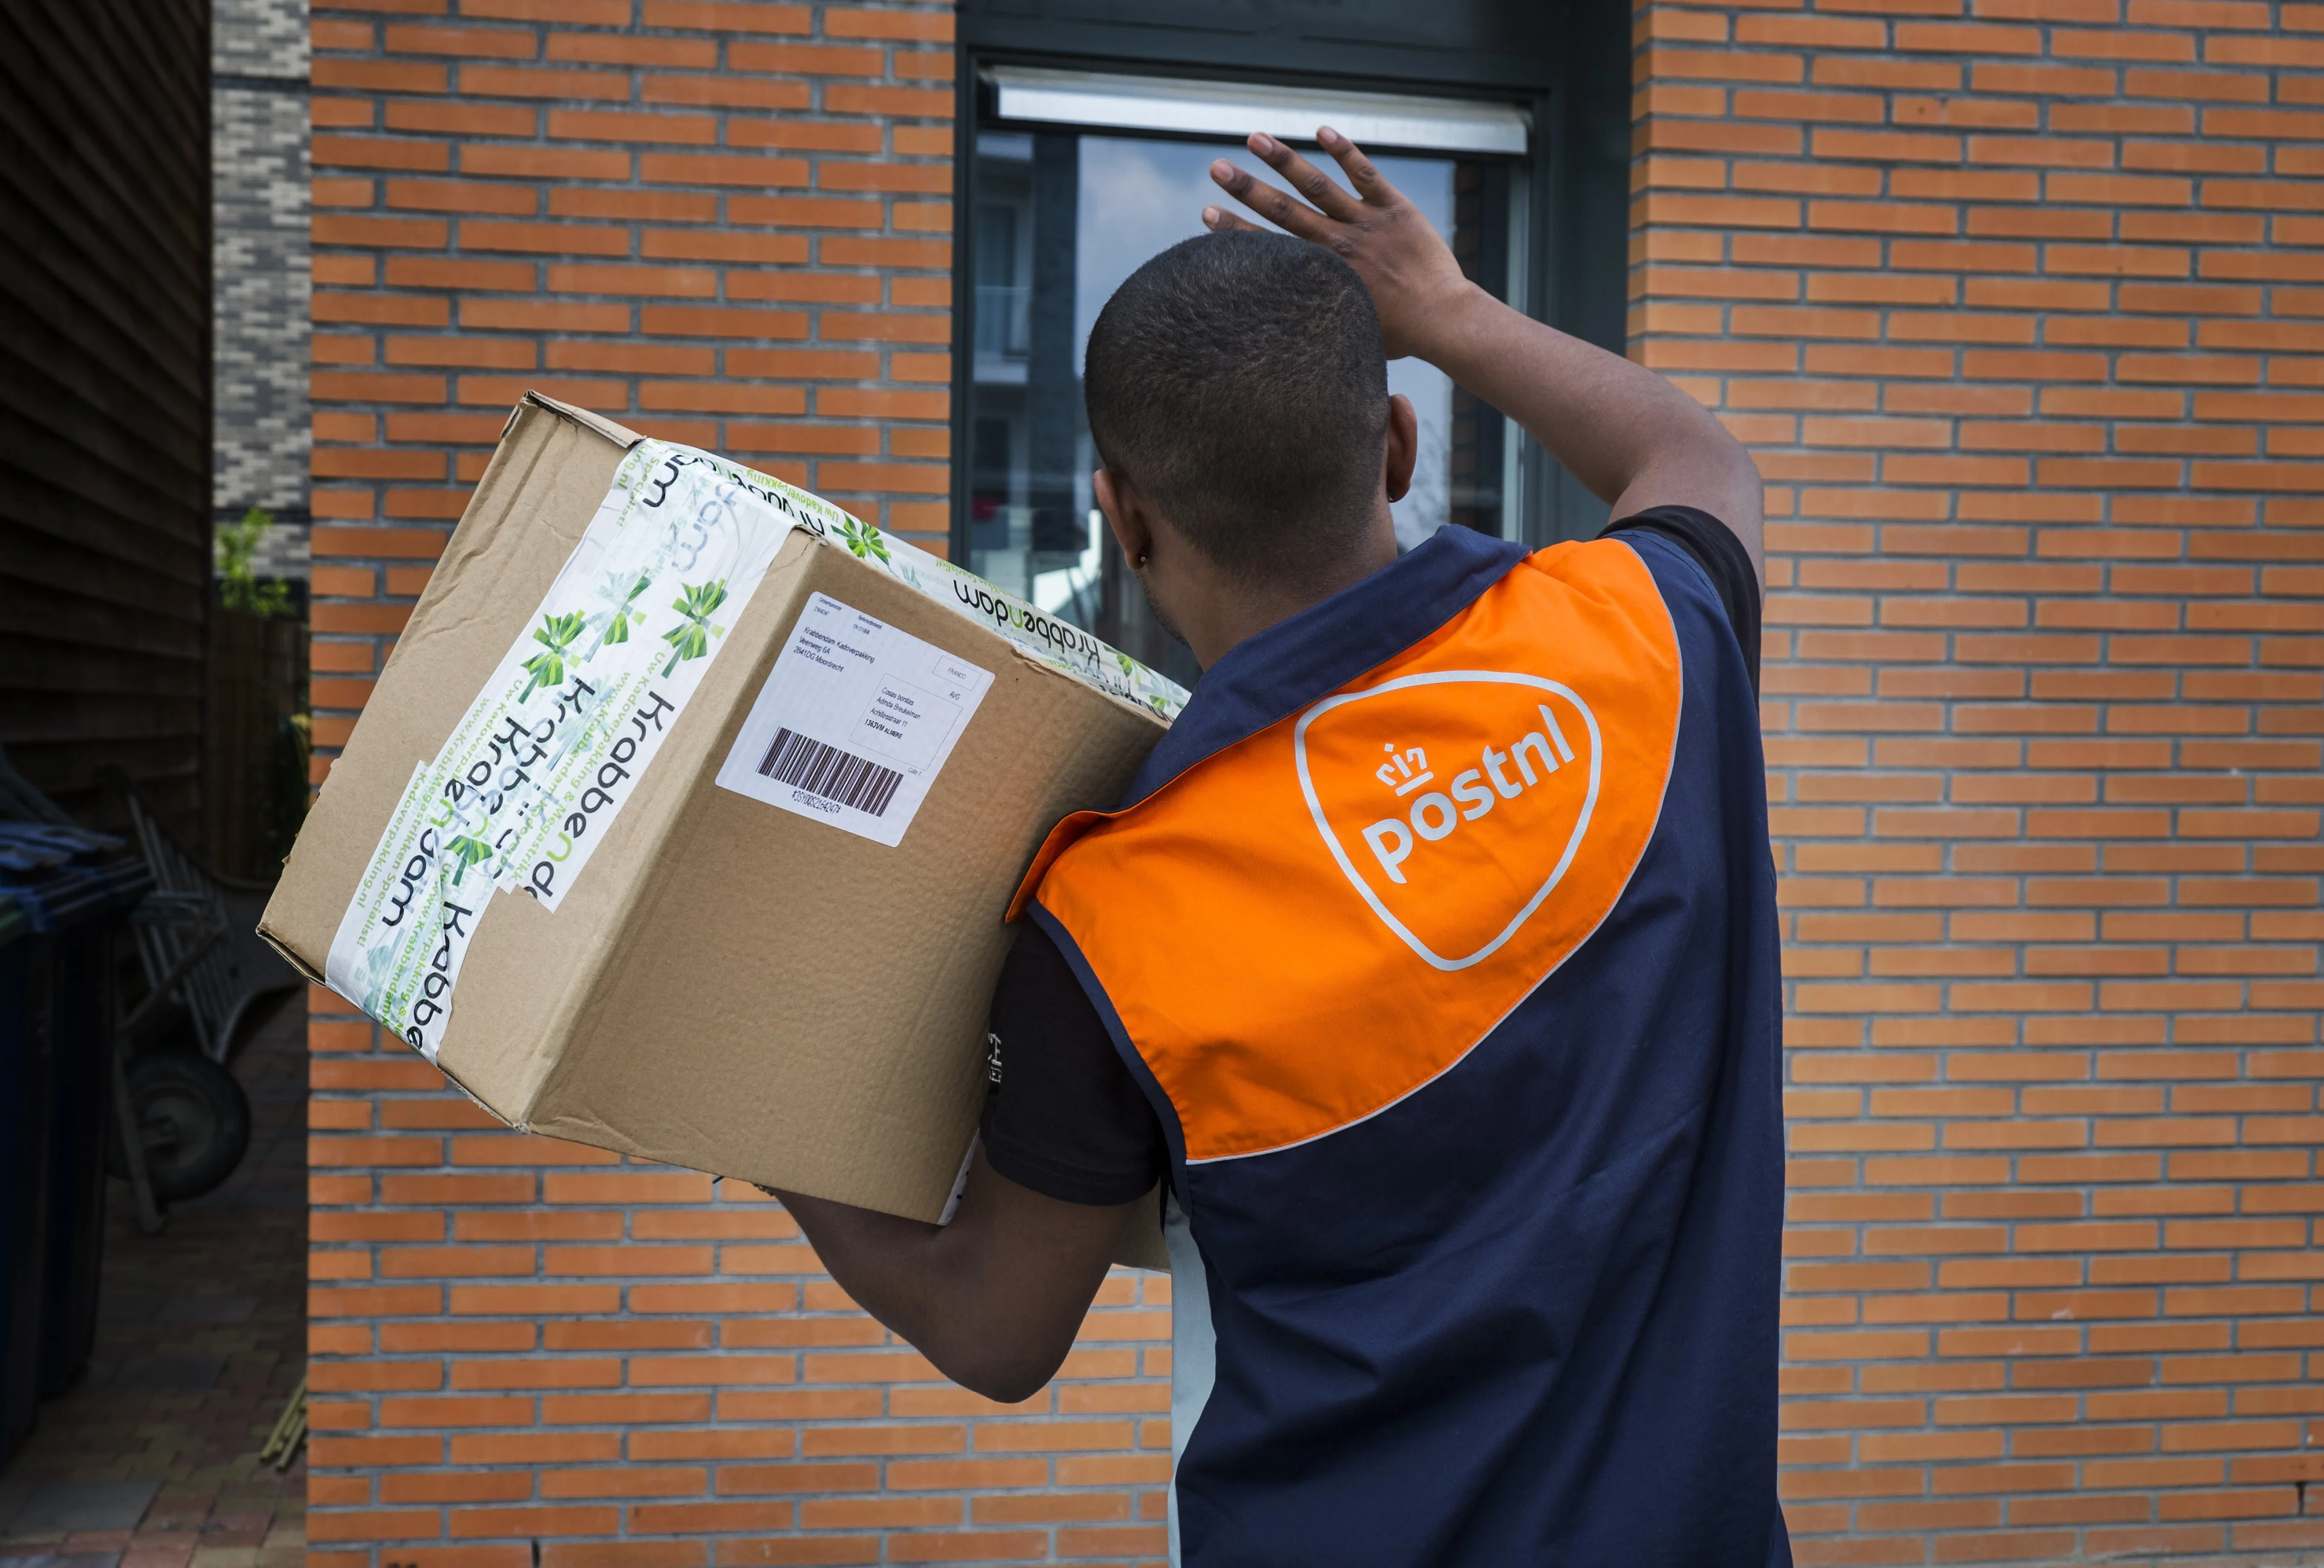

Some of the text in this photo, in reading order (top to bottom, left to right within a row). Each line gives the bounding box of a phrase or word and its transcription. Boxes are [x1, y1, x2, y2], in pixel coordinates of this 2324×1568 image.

[953, 579, 1099, 669] Krabbendam
[799, 636, 831, 655] Veenweg 6A
[804, 626, 875, 664] Krabbendam Kadoverpakking
[645, 651, 666, 675] Uw
[793, 645, 844, 672] 2841DG Moordrecht
[948, 668, 967, 680] FRANCO
[504, 678, 523, 702] Uw
[882, 687, 897, 698] Cosas
[948, 691, 960, 700] AVG
[870, 707, 902, 726] Achillesstraat
[876, 696, 921, 720] Adinda Breukelman
[569, 675, 649, 790] Kadoverpakking
[884, 727, 904, 739] ALMERE
[561, 790, 574, 805] &
[1362, 704, 1575, 884] postnl
[391, 772, 445, 870] Megastrikken
[356, 873, 396, 947] Specialist!
[396, 1006, 407, 1018] &
